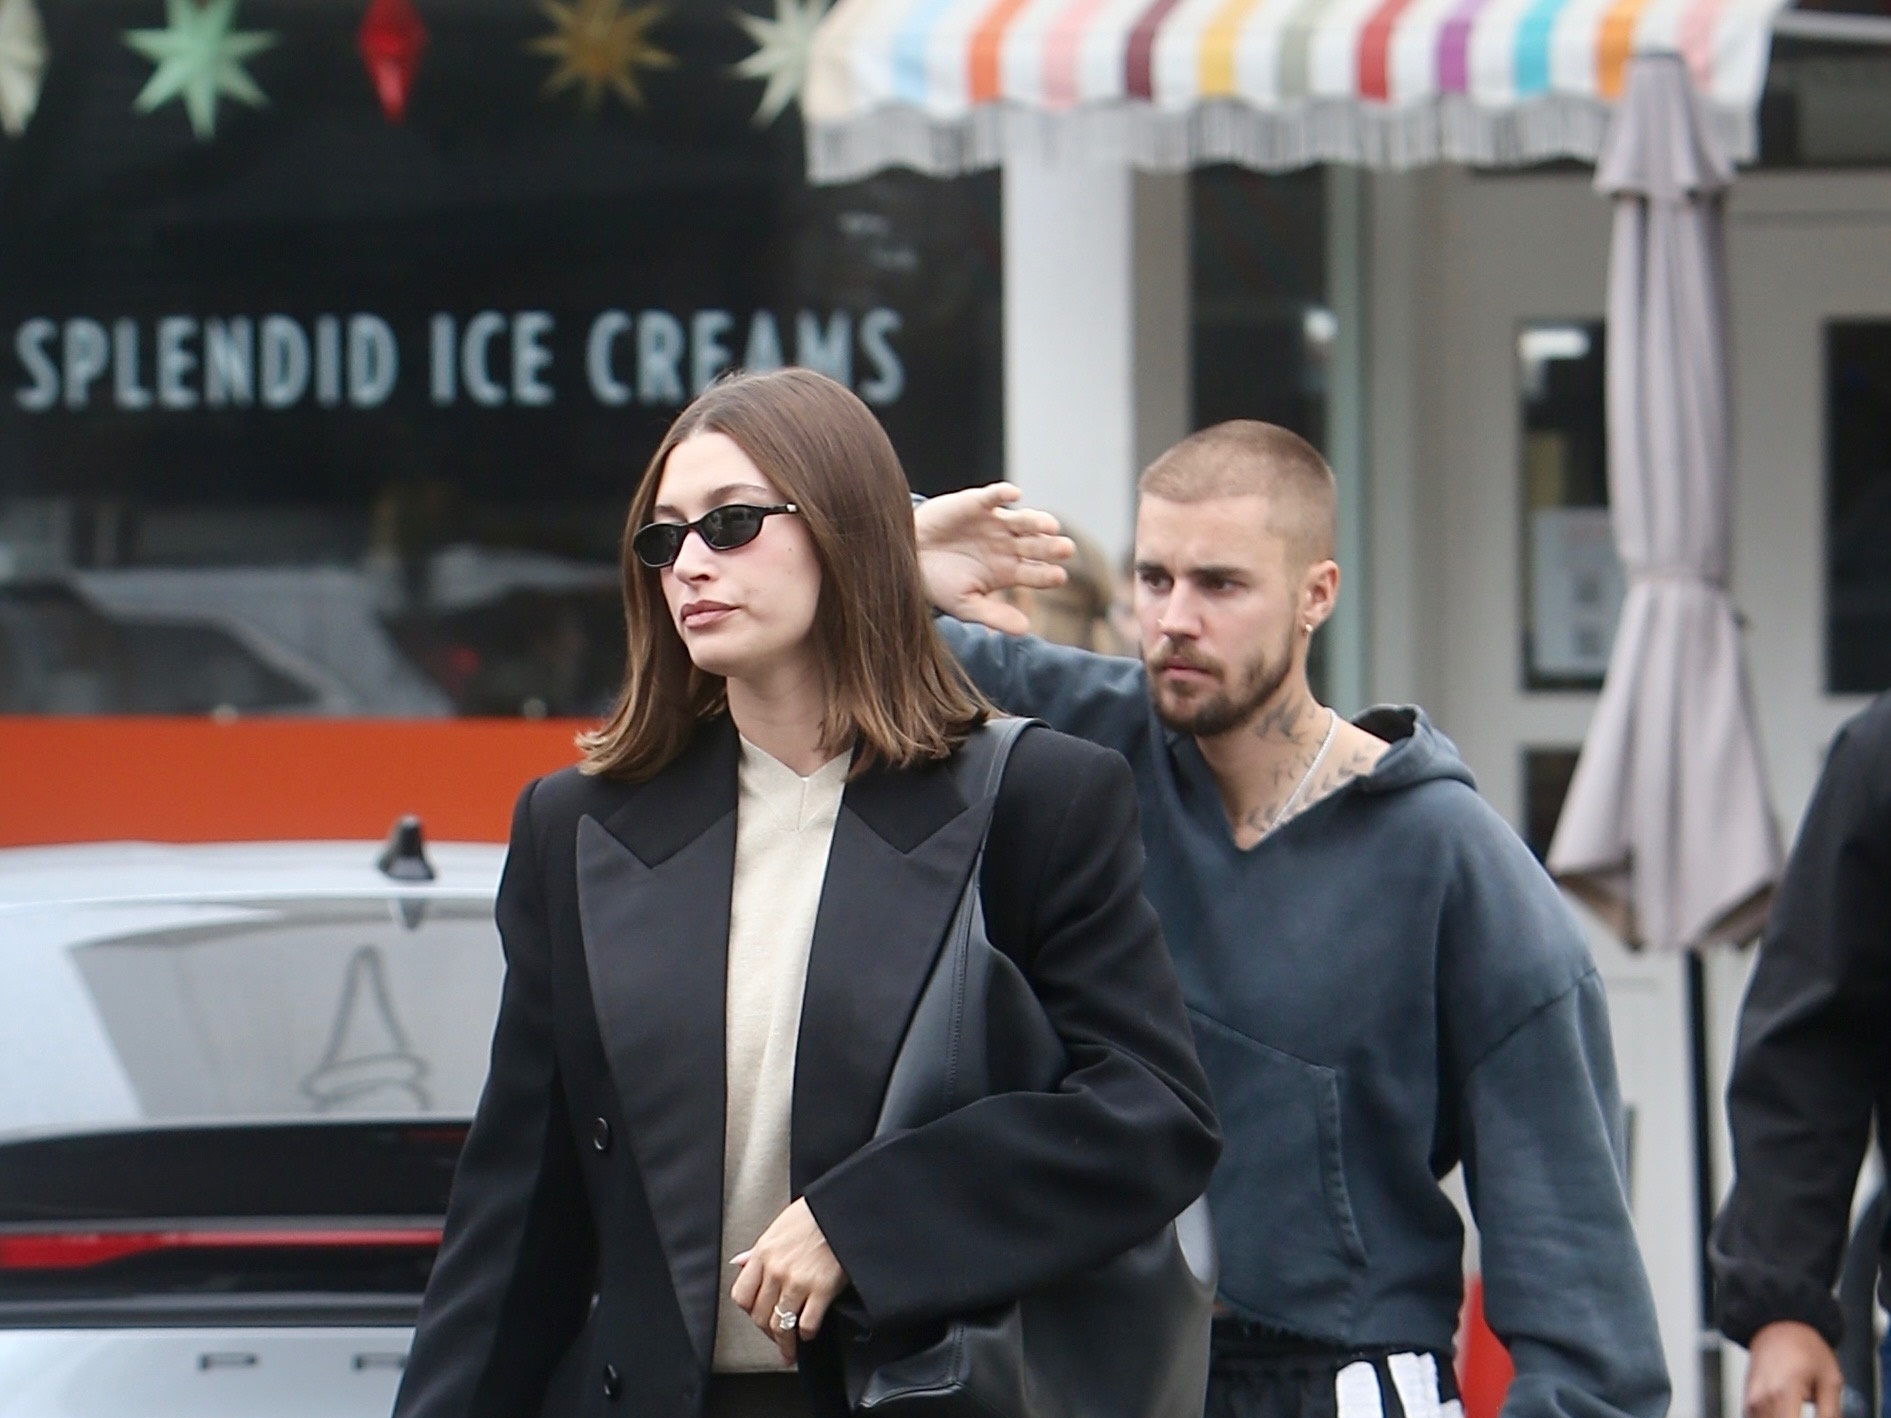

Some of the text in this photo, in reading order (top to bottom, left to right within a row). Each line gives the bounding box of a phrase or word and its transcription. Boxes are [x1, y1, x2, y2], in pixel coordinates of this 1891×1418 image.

[16, 308, 904, 410] SPLENDID ICE CREAMS
